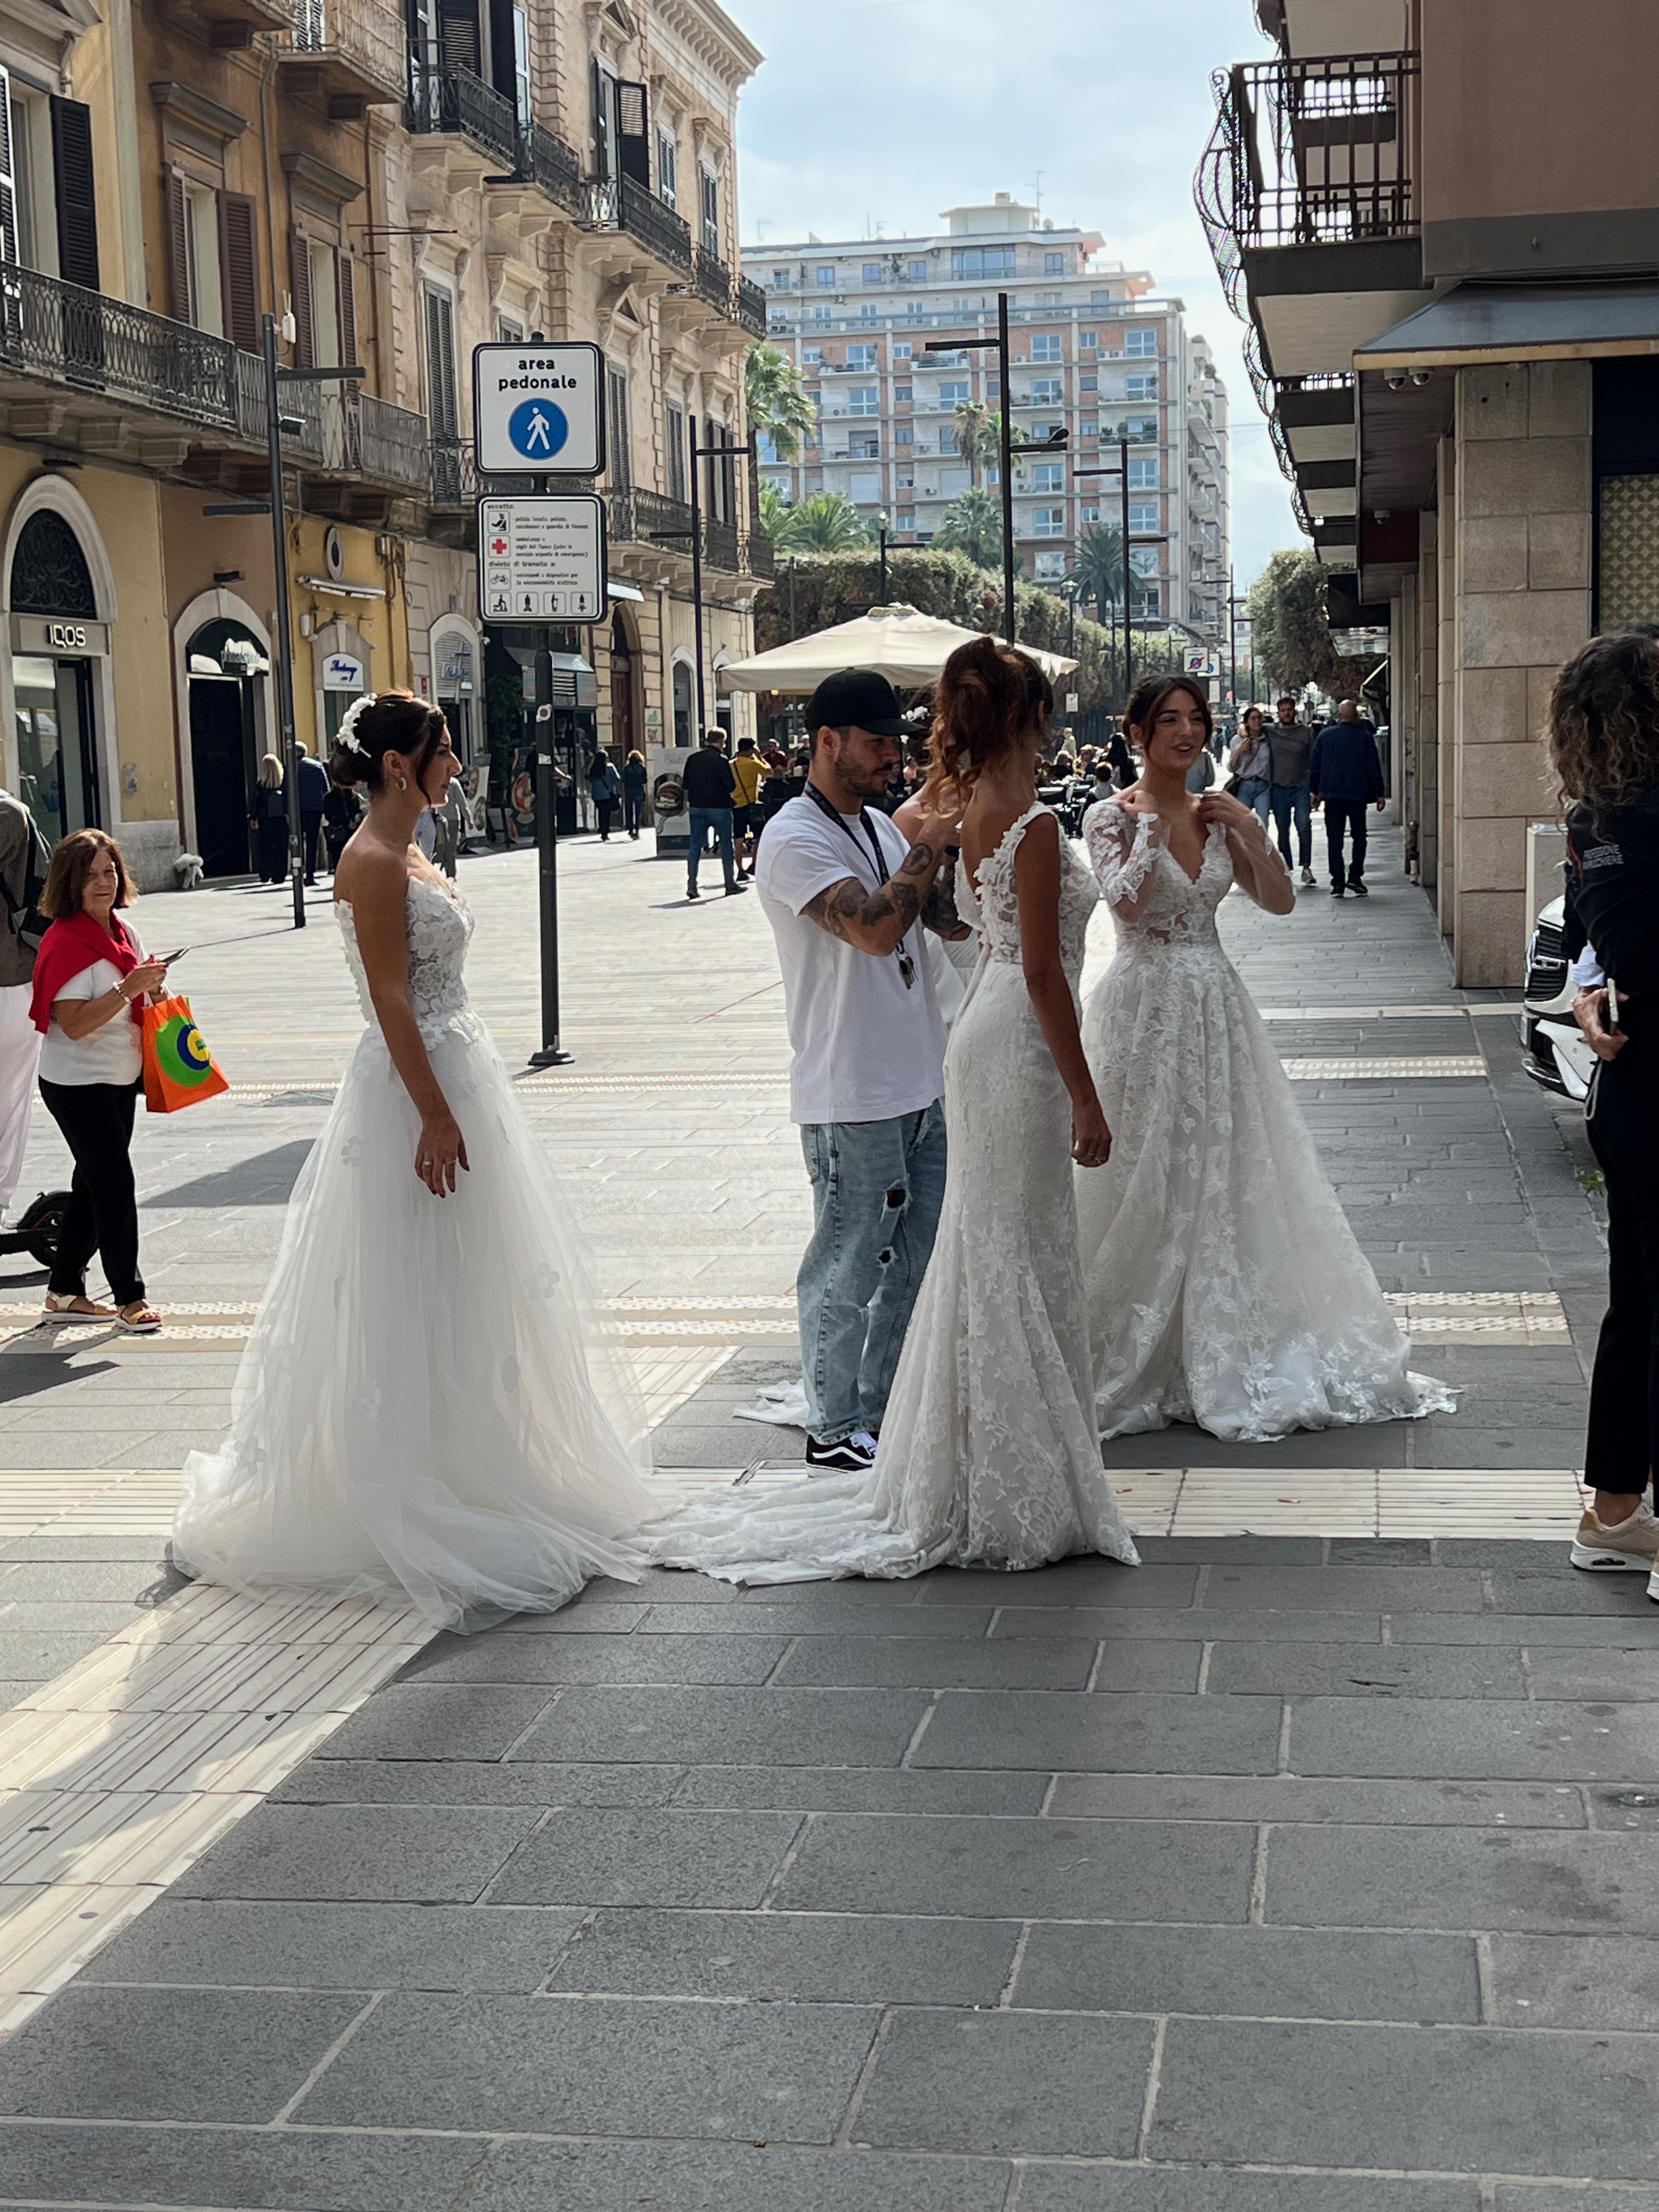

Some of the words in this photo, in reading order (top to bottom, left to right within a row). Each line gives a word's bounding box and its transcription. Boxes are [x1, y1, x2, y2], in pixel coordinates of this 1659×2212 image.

[518, 359, 555, 370] area
[499, 375, 577, 392] pedonale
[47, 624, 86, 648] IQOS
